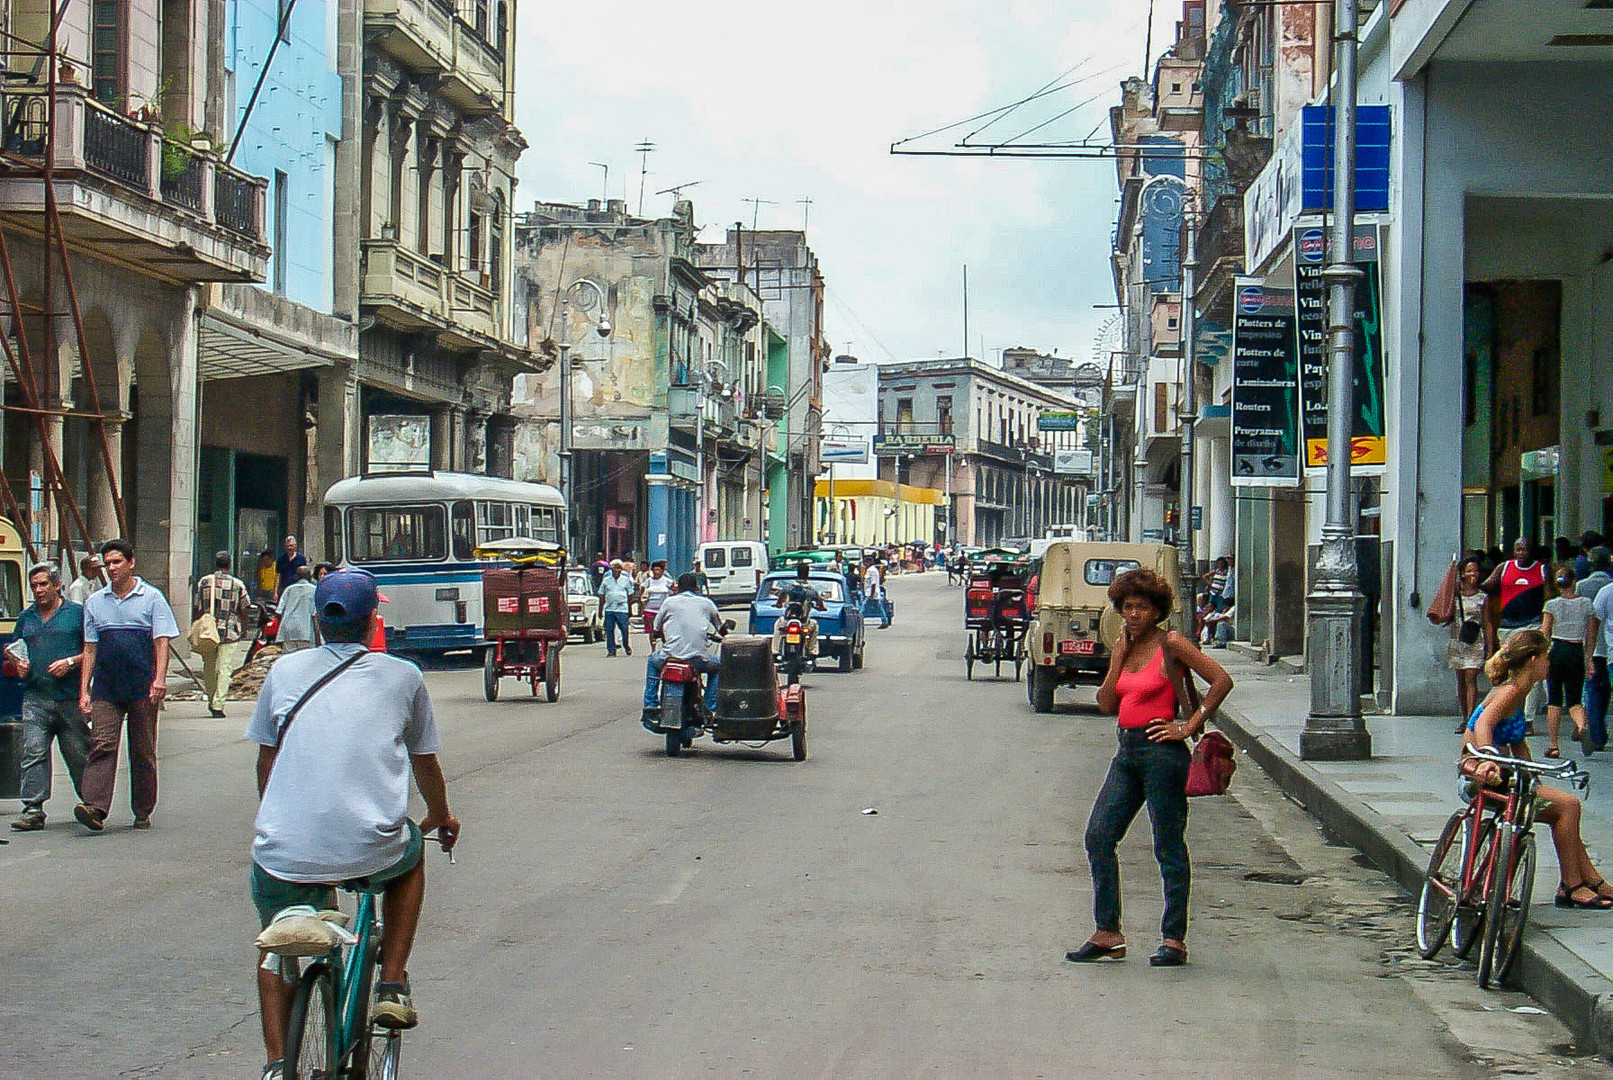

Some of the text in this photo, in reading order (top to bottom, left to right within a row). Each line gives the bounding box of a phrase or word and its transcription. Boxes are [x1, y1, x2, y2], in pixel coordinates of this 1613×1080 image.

[1274, 319, 1286, 328] de
[1237, 347, 1285, 357] Plotters de
[1235, 401, 1271, 411] Routers
[1234, 426, 1283, 437] Programas
